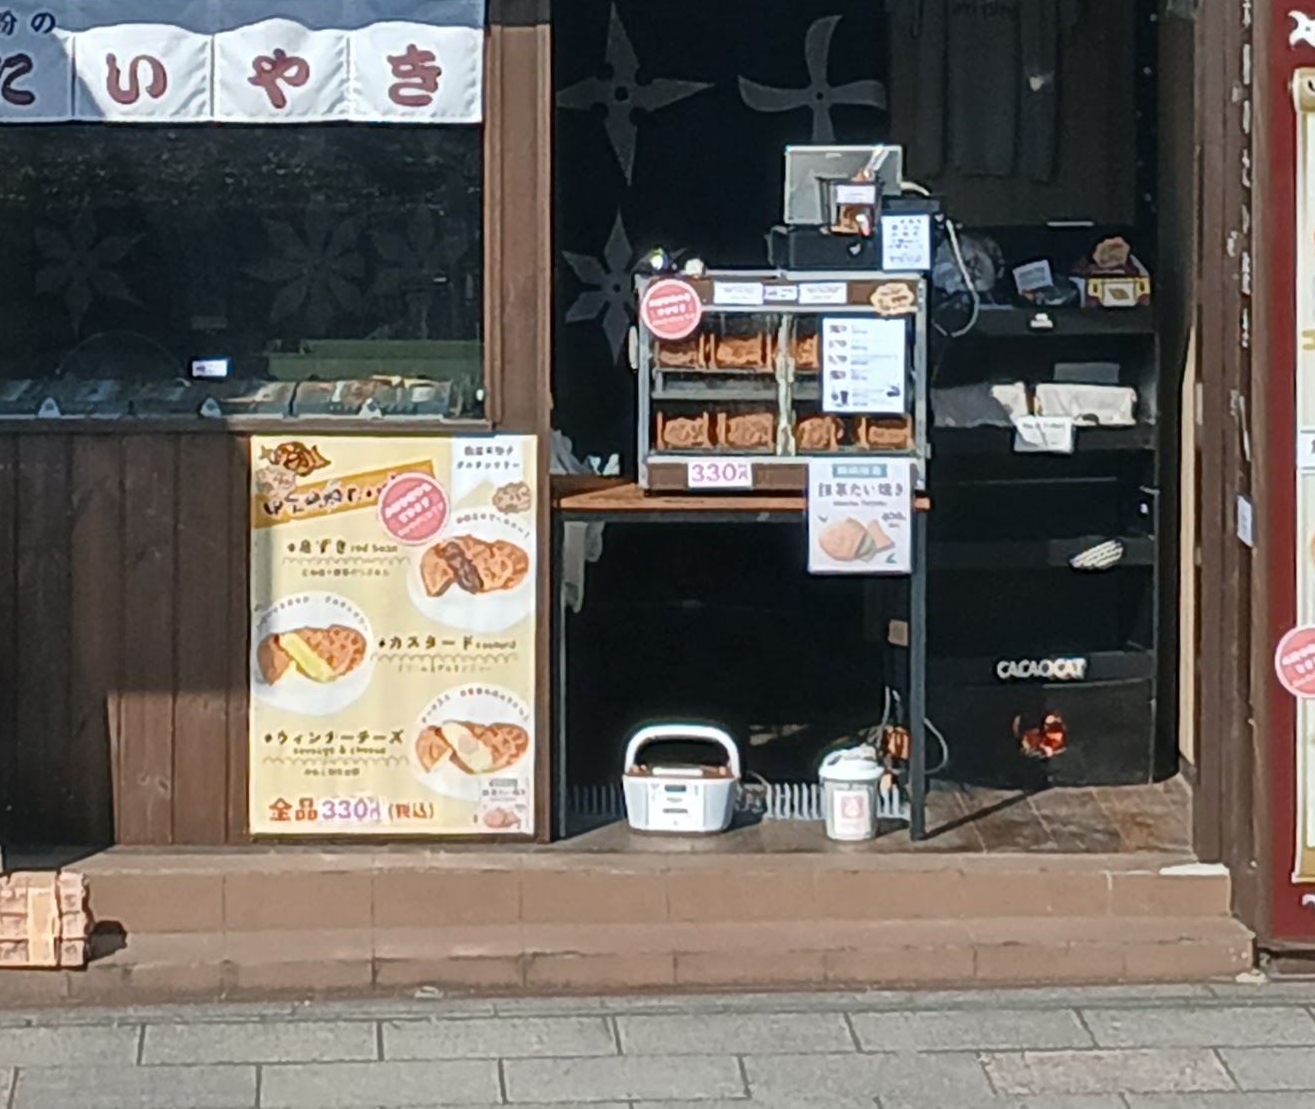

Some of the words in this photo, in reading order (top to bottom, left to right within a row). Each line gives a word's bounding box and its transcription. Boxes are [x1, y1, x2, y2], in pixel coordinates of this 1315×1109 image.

[389, 635, 473, 650] カスタード
[996, 657, 1086, 680] CACAOCAT
